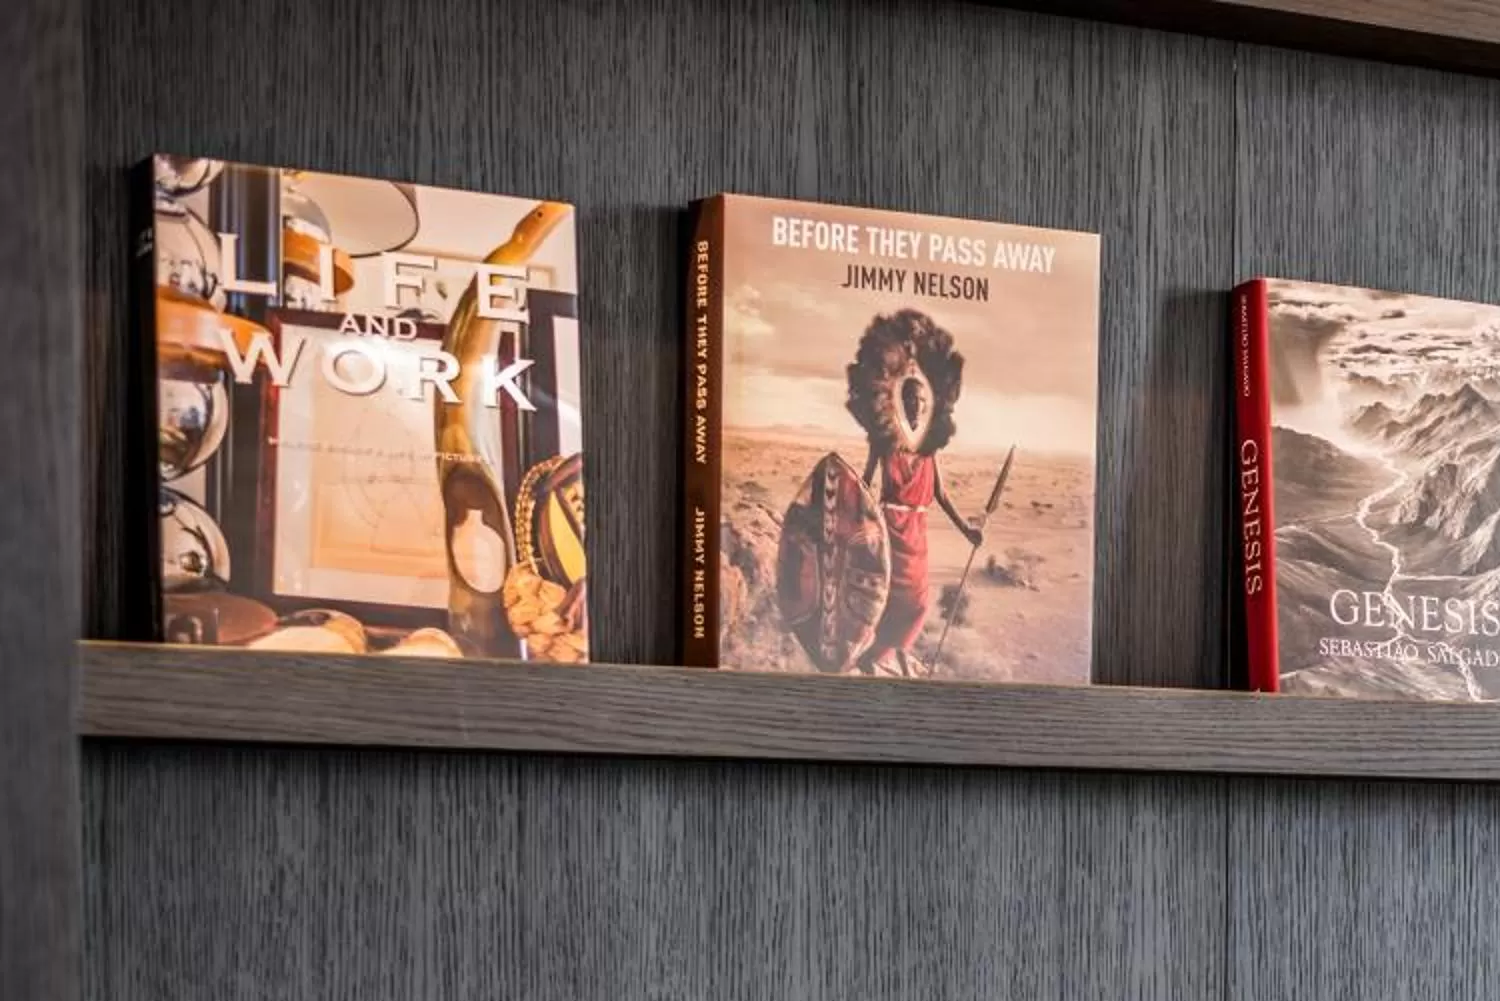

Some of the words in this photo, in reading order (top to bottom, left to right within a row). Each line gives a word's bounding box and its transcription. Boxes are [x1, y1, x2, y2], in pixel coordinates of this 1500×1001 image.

[772, 216, 859, 255] BEFORE
[866, 227, 924, 261] THEY
[930, 235, 987, 268] PASS
[993, 243, 1056, 273] AWAY
[218, 232, 531, 325] LIFE
[697, 240, 709, 308] BEFORE
[842, 264, 906, 294] JIMMY
[913, 271, 989, 302] NELSON
[340, 313, 418, 341] AND
[697, 314, 707, 358] THEY
[220, 328, 536, 412] WORK
[696, 364, 707, 410] PASS
[695, 415, 706, 464] AWAY
[694, 506, 705, 564] JIMMY
[1239, 438, 1264, 596] GENESIS
[693, 569, 705, 639] NELSON
[1329, 589, 1500, 637] GENESIS
